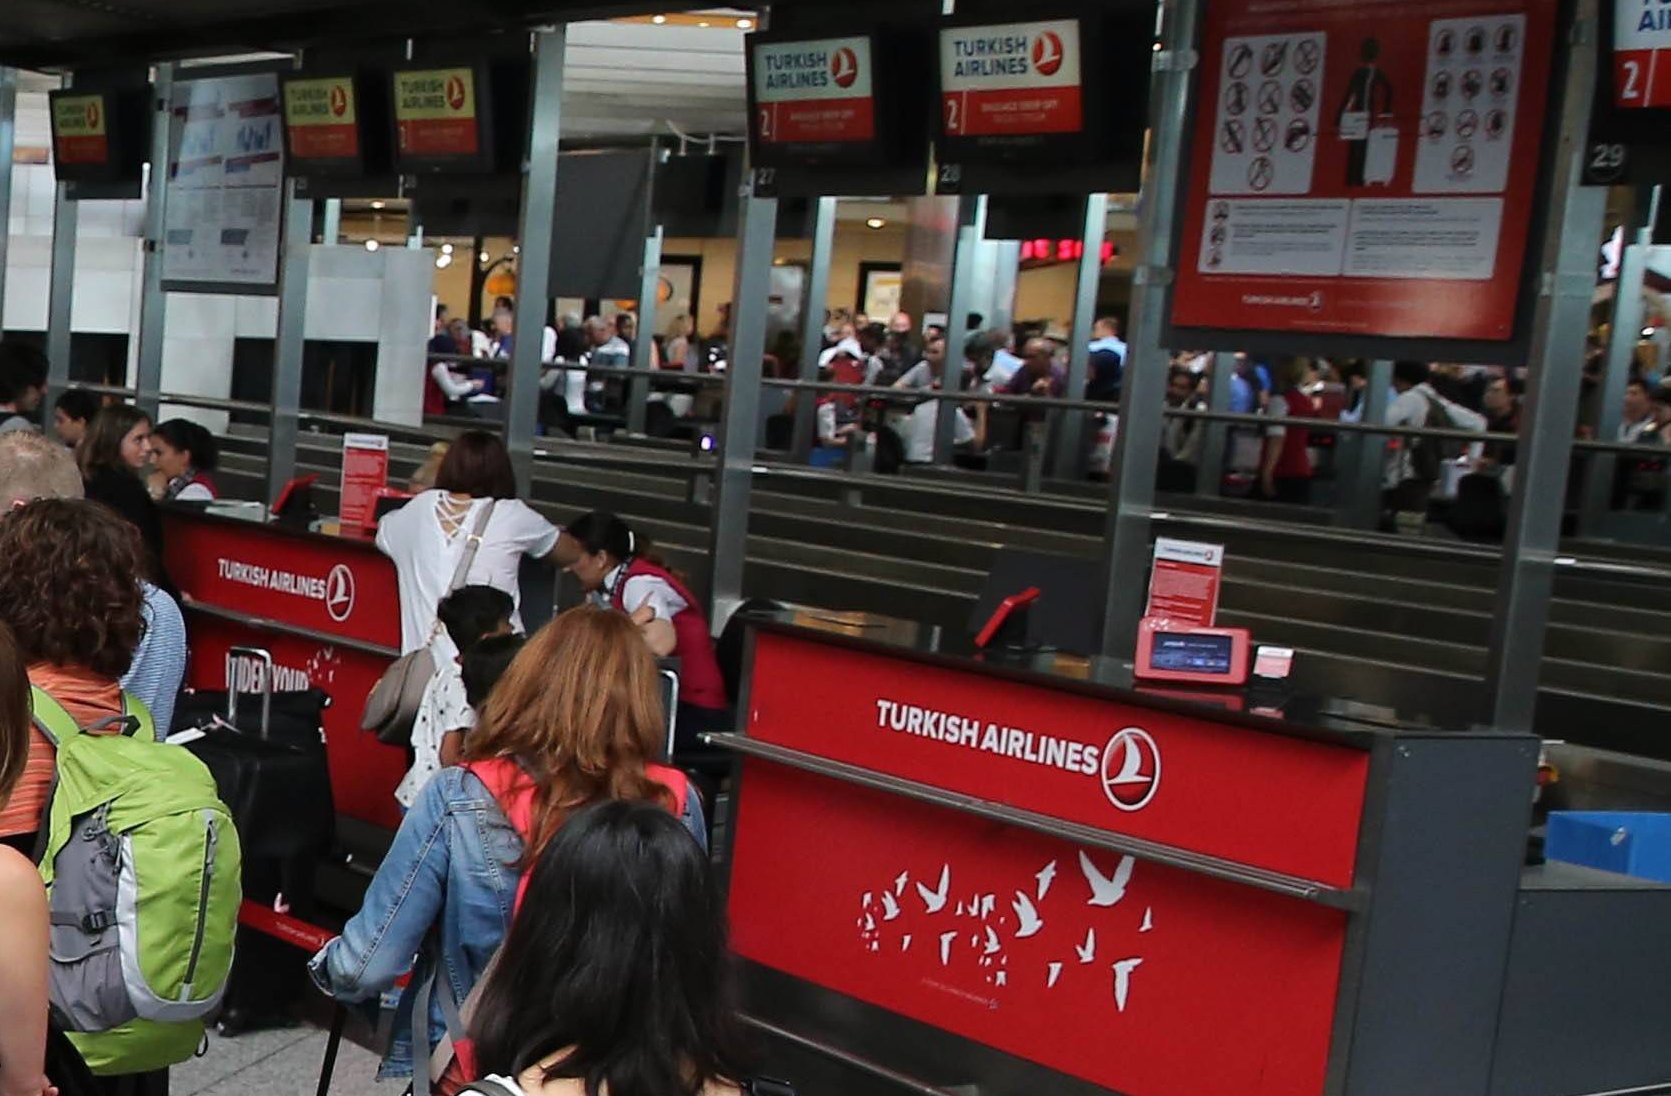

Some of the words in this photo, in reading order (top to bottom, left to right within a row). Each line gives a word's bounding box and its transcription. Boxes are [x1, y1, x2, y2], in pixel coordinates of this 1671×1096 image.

[953, 36, 1027, 57] TURKISH
[765, 53, 827, 71] TURKISH
[954, 57, 1028, 77] AIRLINES
[766, 71, 828, 91] AIRLINES
[1622, 60, 1640, 99] 2
[761, 110, 770, 136] 2
[947, 99, 958, 130] 2
[1591, 143, 1625, 168] 29
[758, 168, 776, 185] 27
[217, 558, 270, 587] TURKISH
[269, 570, 326, 600] AIRLINES
[877, 700, 980, 748] TURKISH
[979, 724, 1100, 776] AIRLINES
